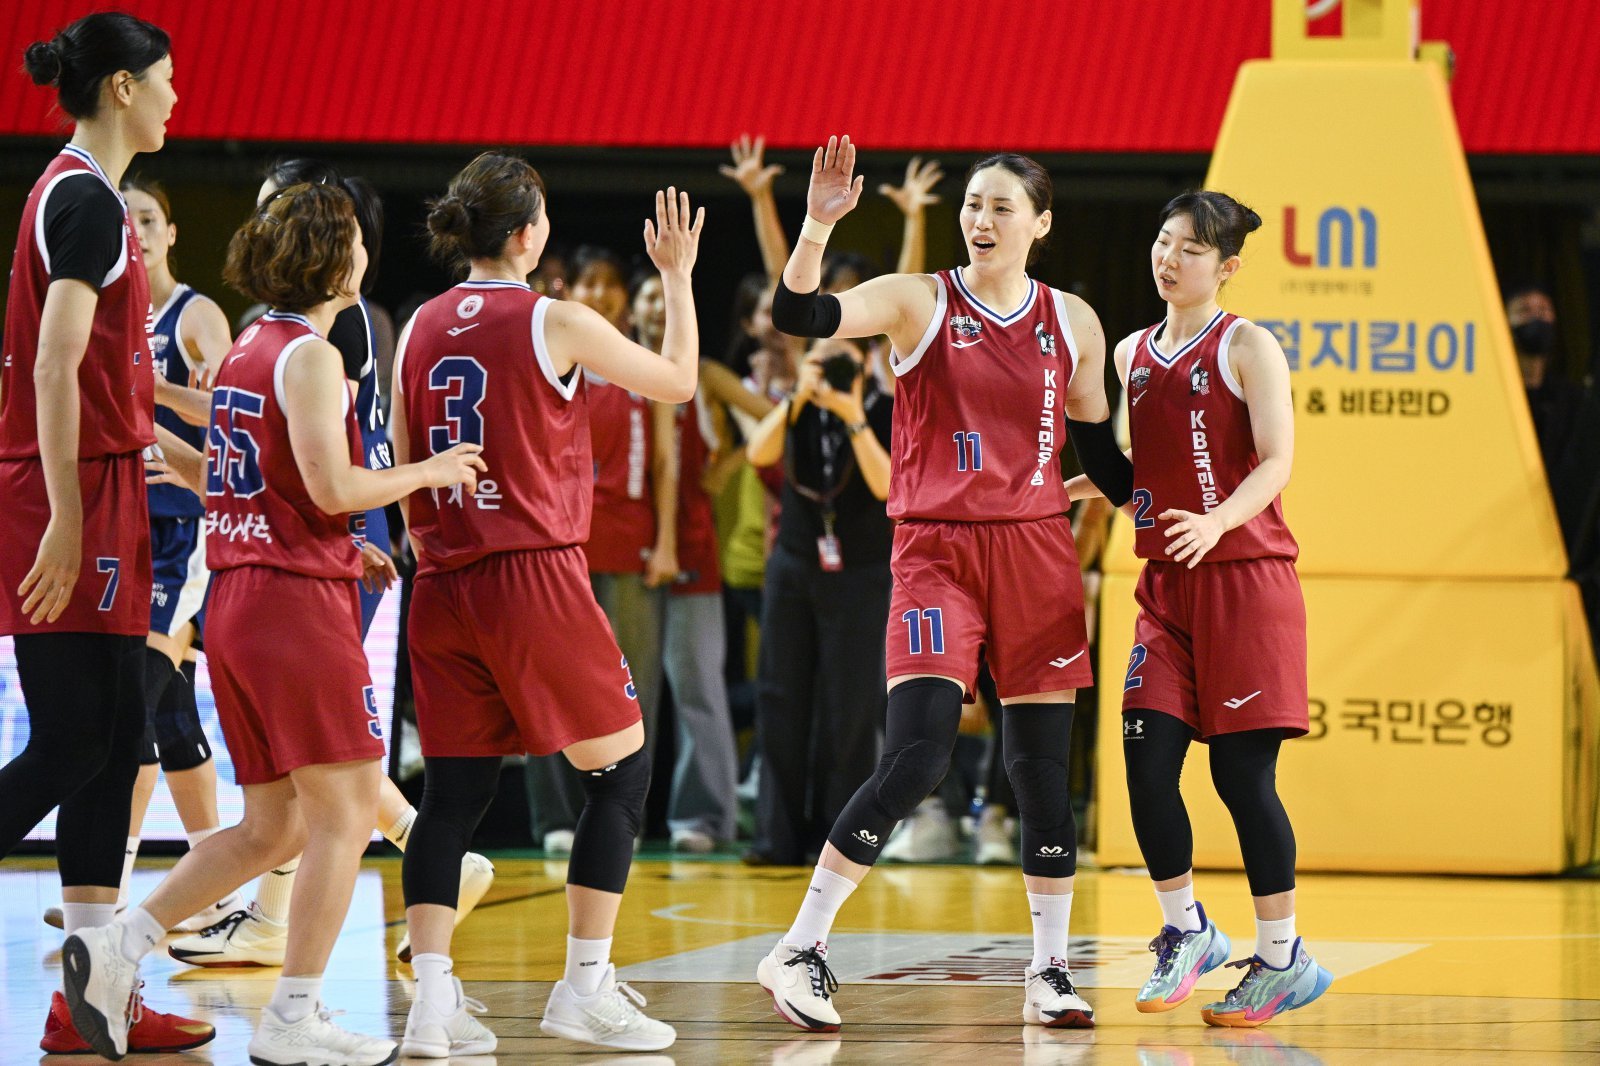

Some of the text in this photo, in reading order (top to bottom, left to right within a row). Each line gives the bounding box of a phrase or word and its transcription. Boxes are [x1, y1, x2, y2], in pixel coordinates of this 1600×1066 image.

[428, 356, 487, 456] 3
[1340, 388, 1451, 417] 비타민D
[952, 431, 983, 472] 11
[1132, 487, 1155, 530] 2
[96, 557, 120, 611] 7
[902, 607, 945, 655] 11
[1123, 643, 1148, 692] 2
